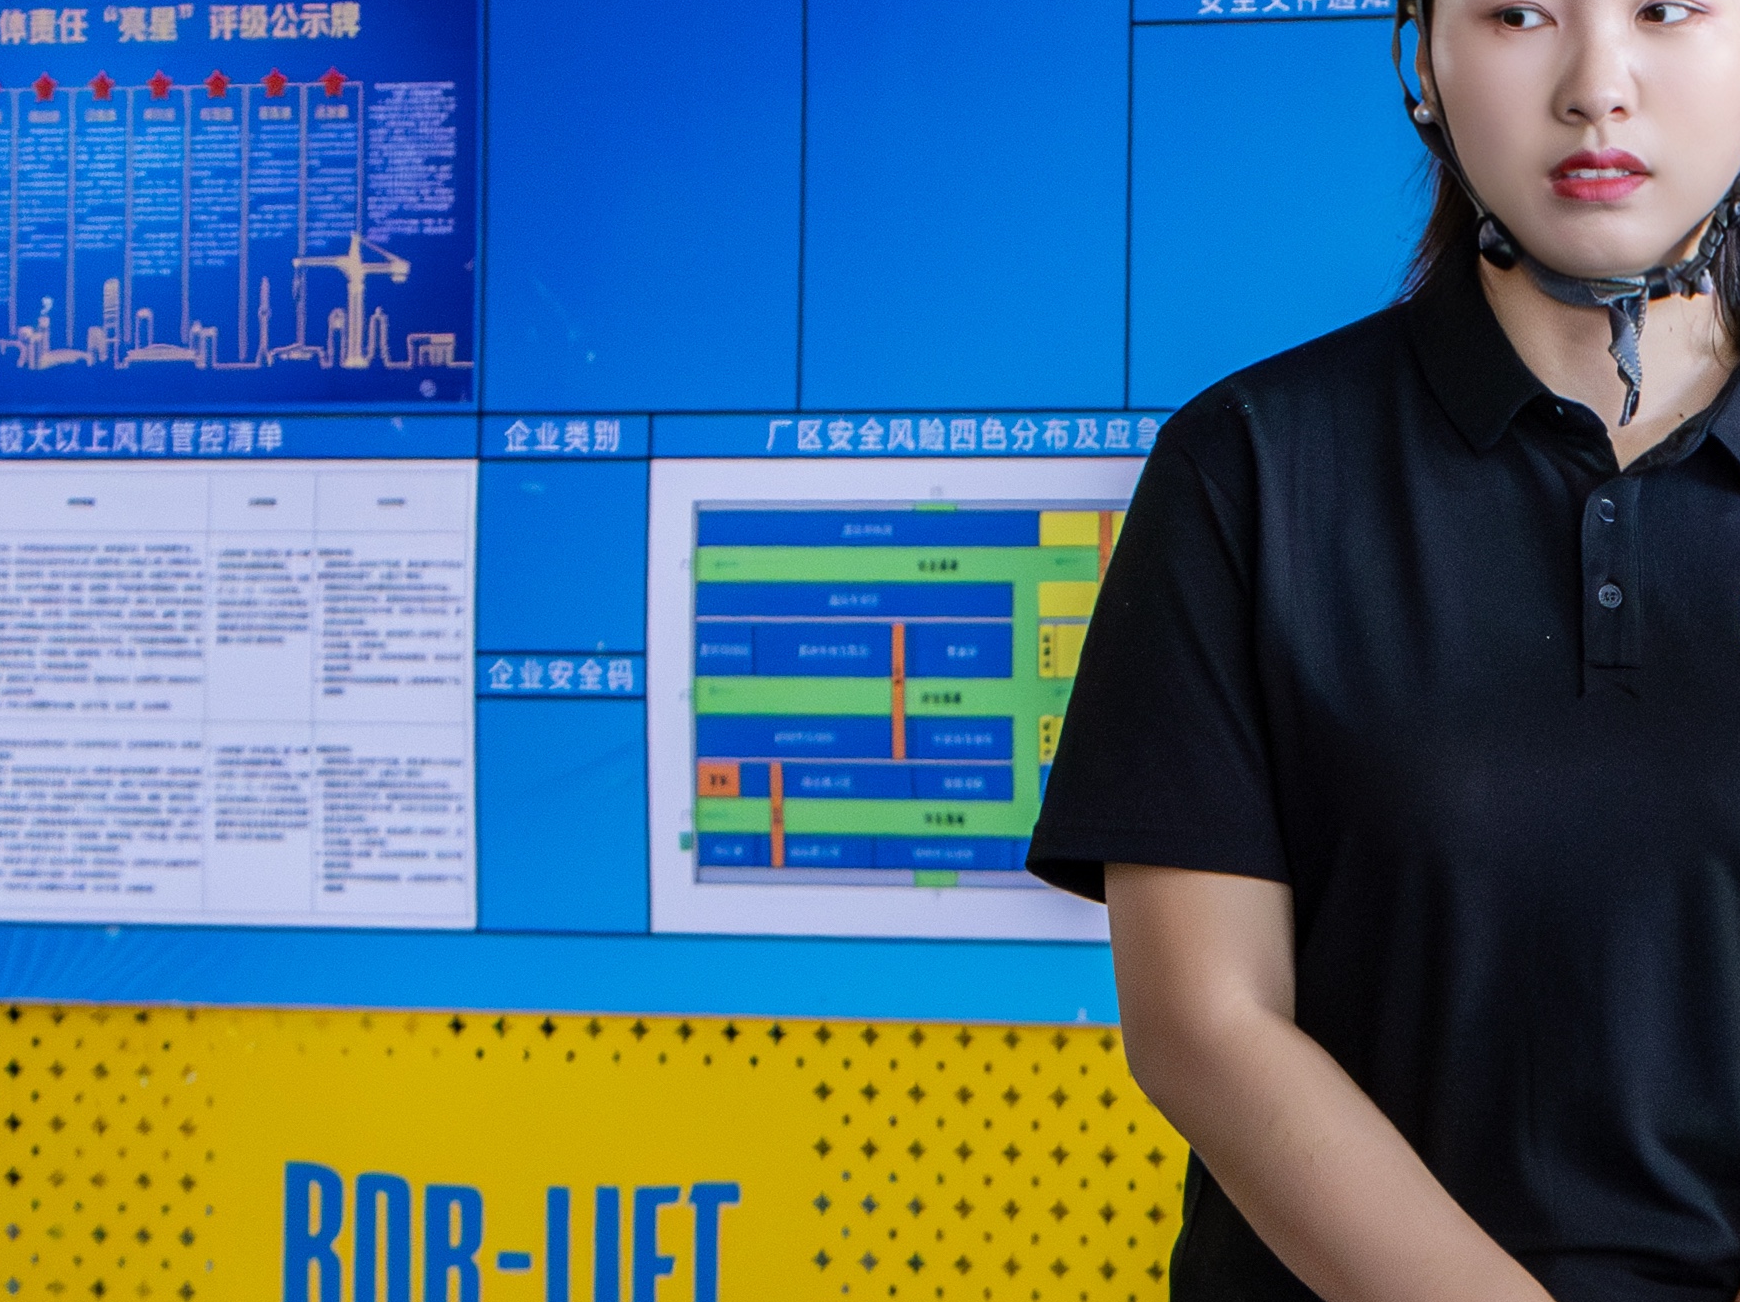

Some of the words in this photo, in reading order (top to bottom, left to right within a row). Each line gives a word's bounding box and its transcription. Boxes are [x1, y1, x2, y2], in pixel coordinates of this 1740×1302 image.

[503, 418, 621, 453] 企业类别
[488, 658, 635, 692] 企业安全码
